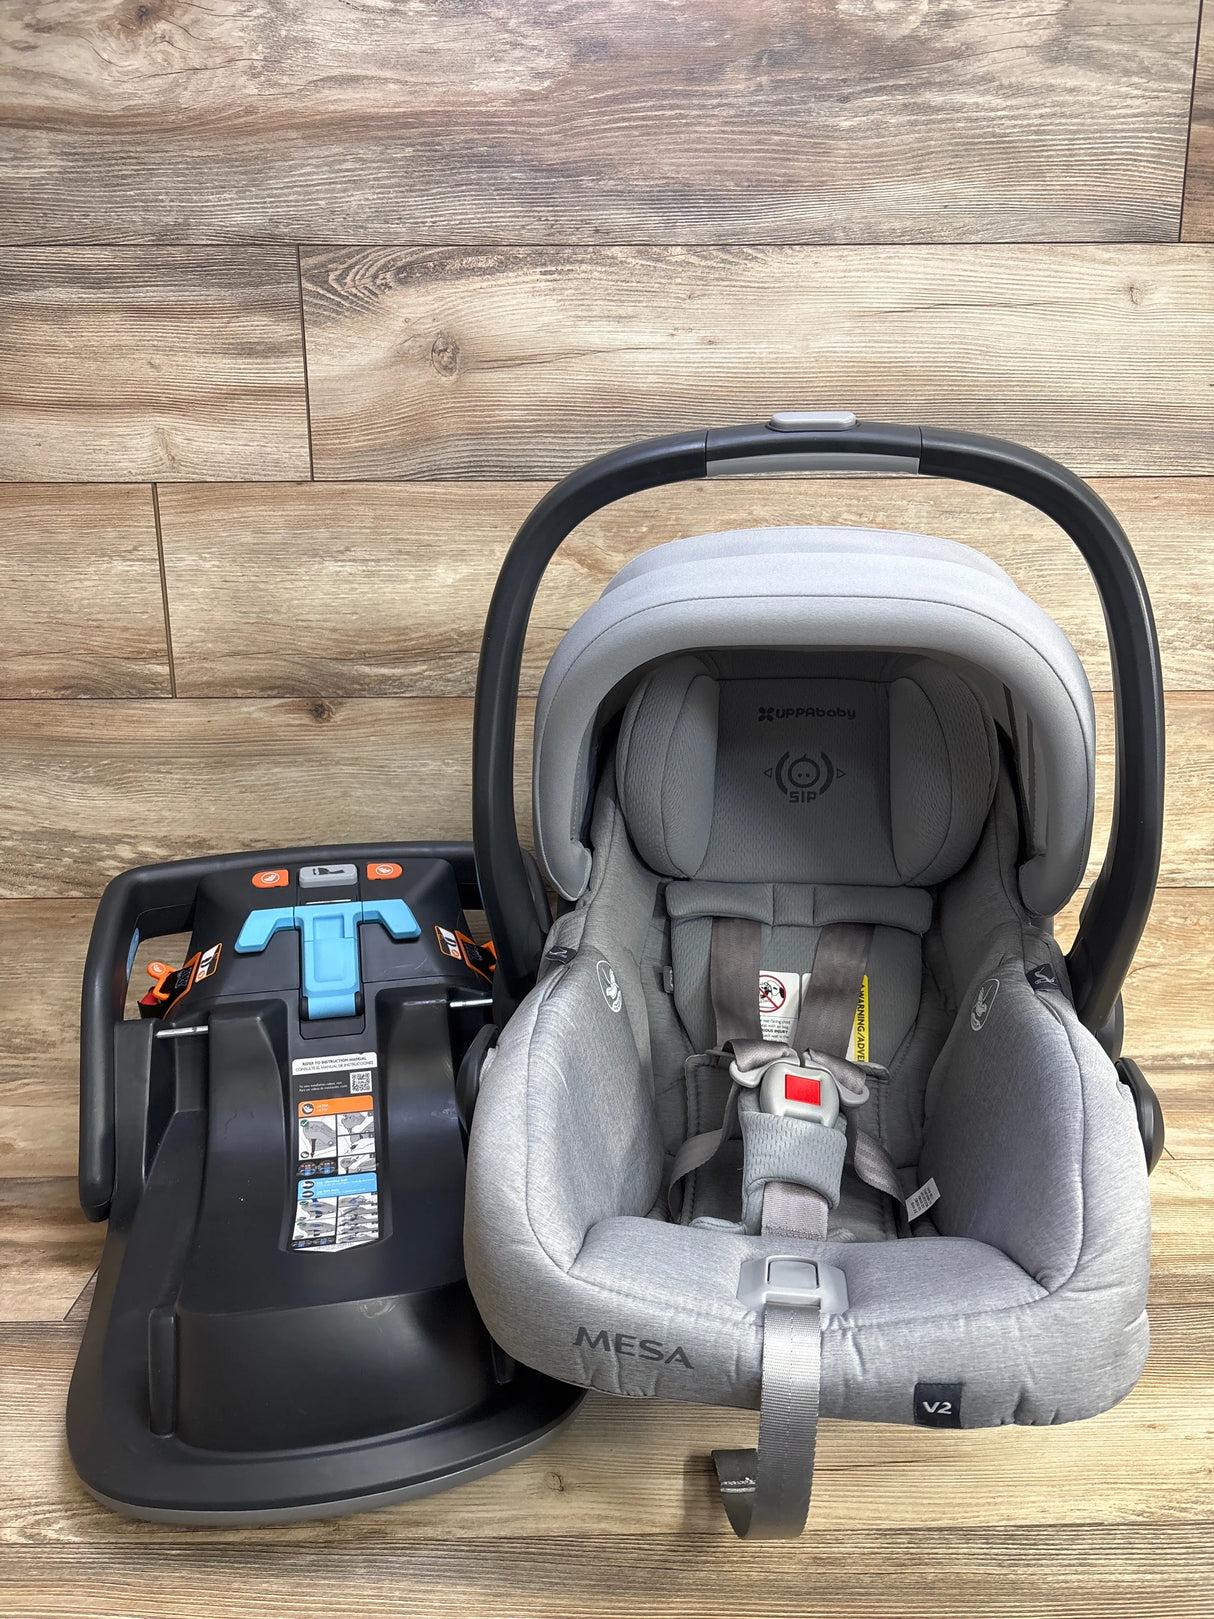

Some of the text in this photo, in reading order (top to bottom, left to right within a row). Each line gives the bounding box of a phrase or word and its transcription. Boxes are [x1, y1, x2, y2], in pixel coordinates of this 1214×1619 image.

[776, 707, 856, 720] UPPAbaby
[789, 791, 816, 803] SIP
[572, 1326, 695, 1369] MESA
[922, 1401, 952, 1415] V2
